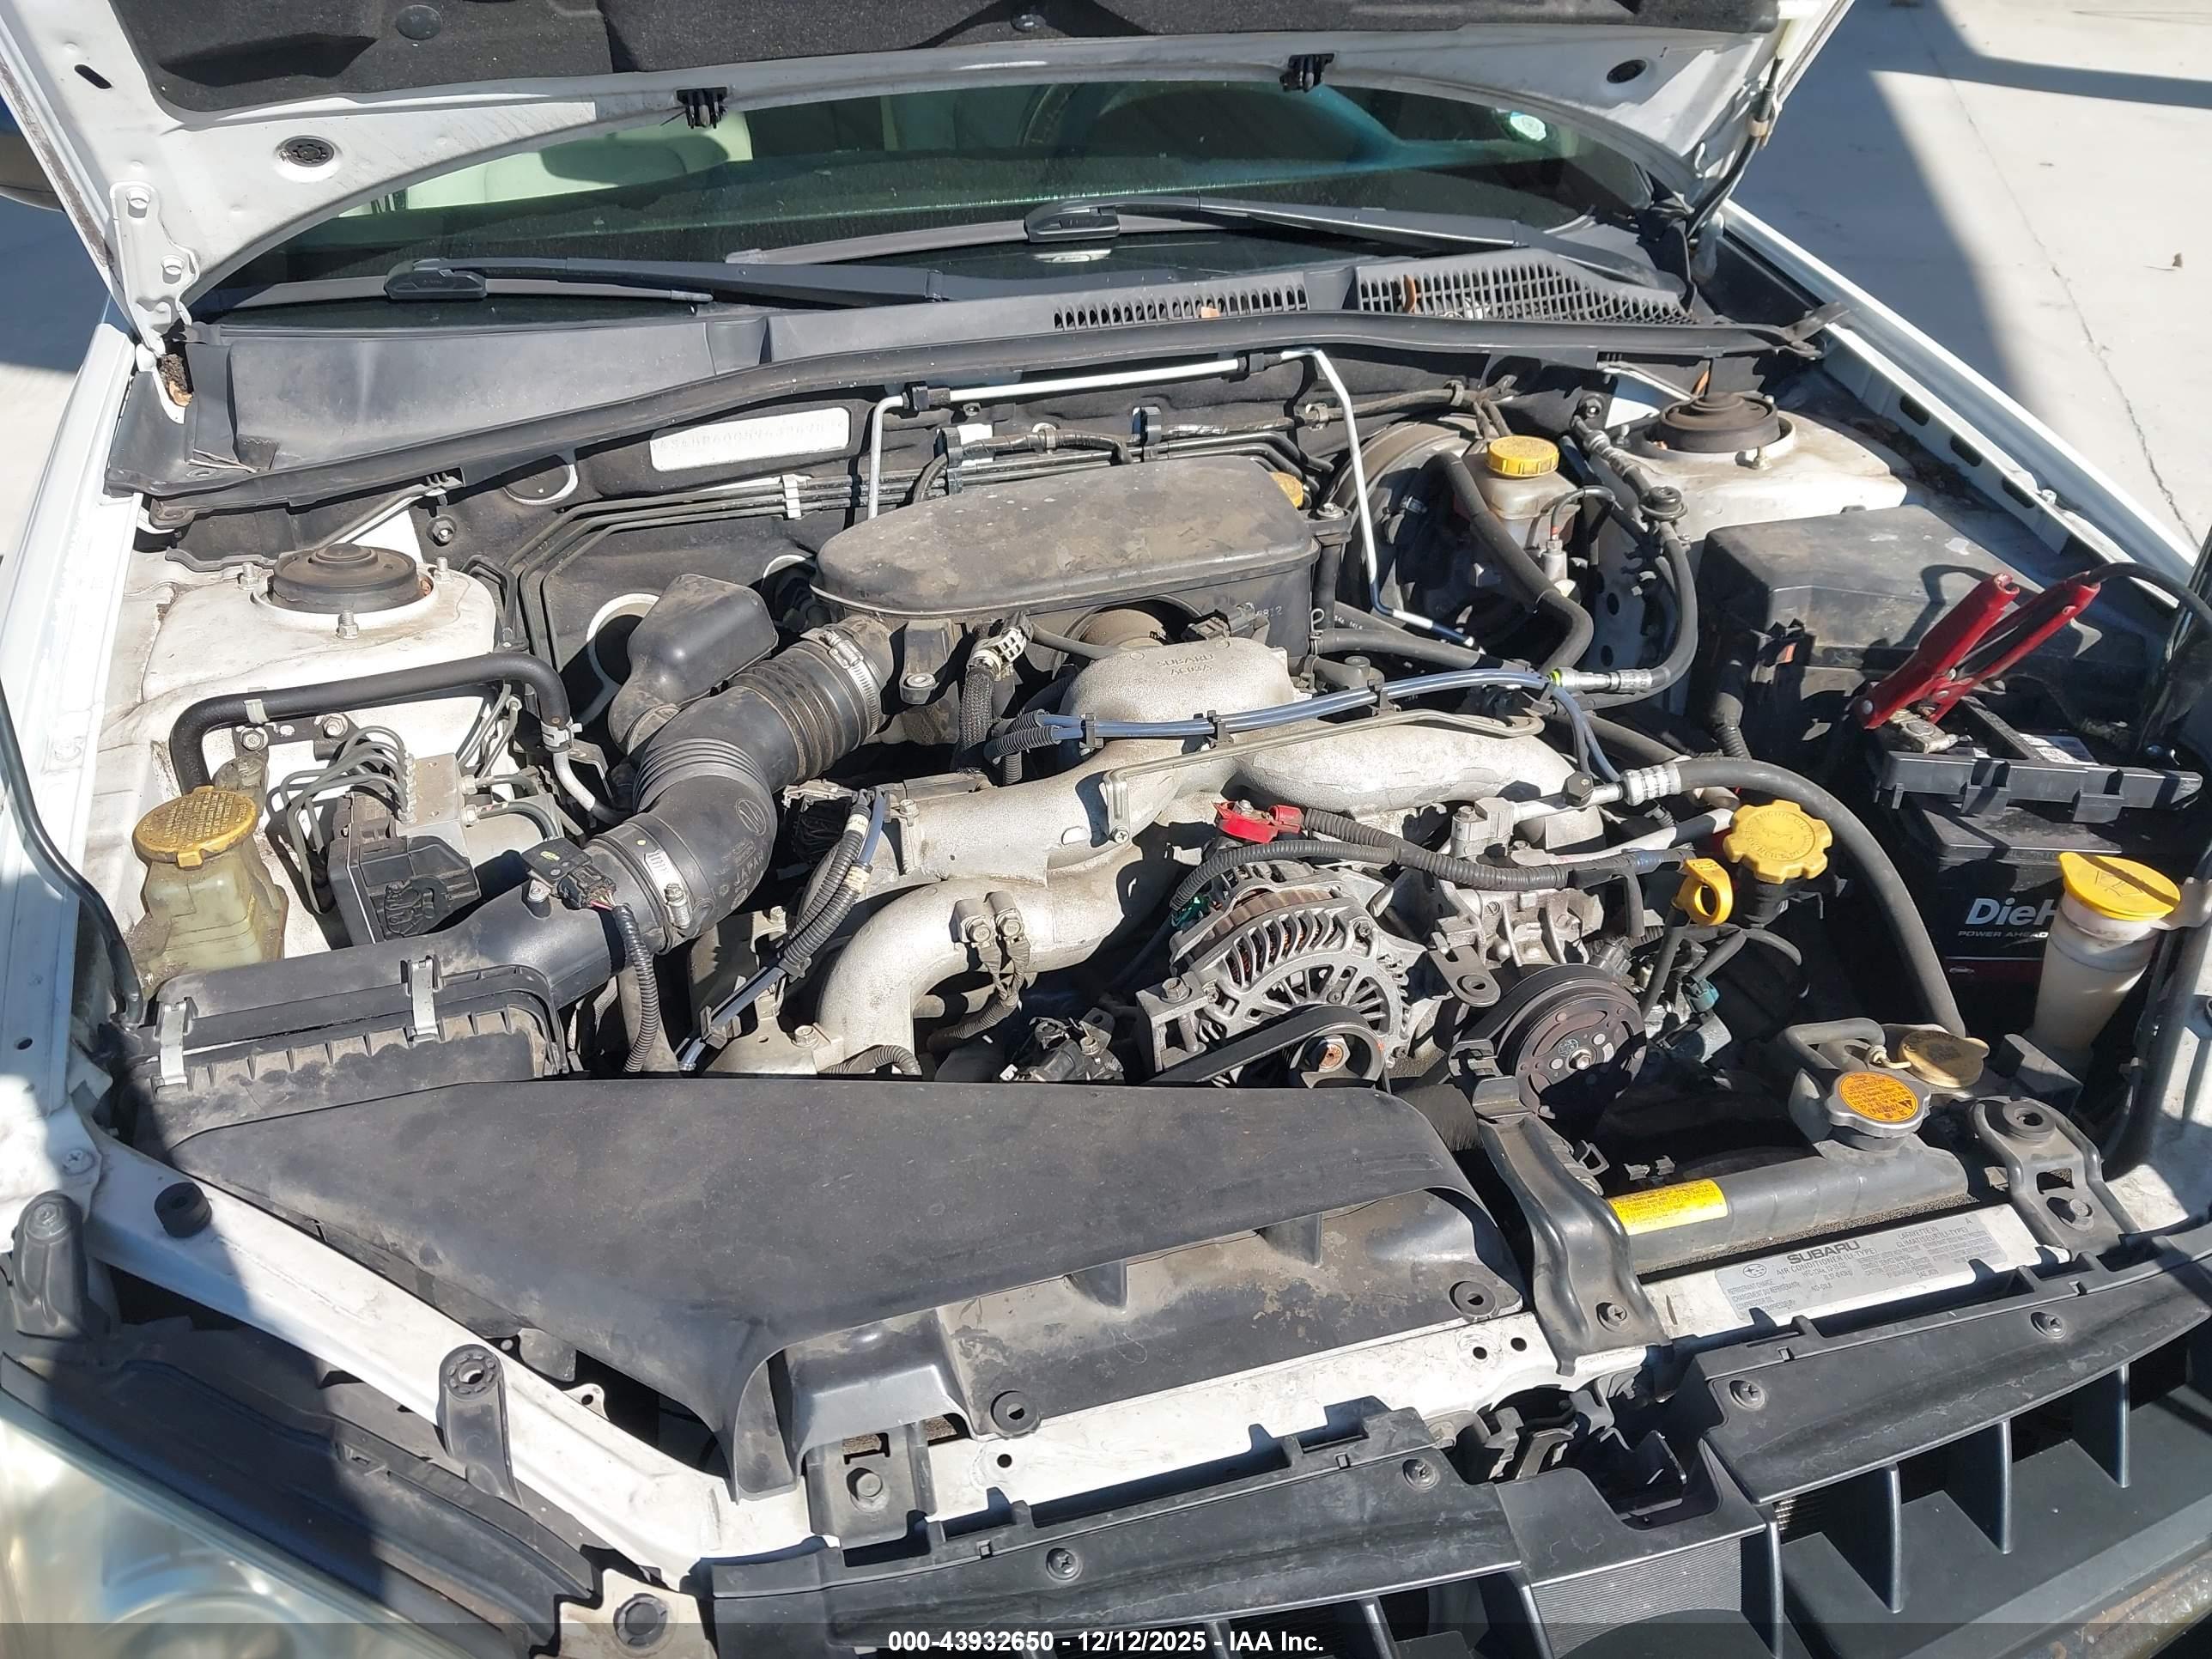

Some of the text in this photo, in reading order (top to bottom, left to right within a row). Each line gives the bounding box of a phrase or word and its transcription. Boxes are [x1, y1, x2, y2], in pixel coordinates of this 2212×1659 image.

[1156, 653, 1214, 667] SUBARU
[734, 849, 764, 886] JAPAN
[1786, 1239, 1861, 1265] SUBARU
[1776, 1267, 1790, 1276] AIR
[1791, 1255, 1842, 1273] CONDITIONER
